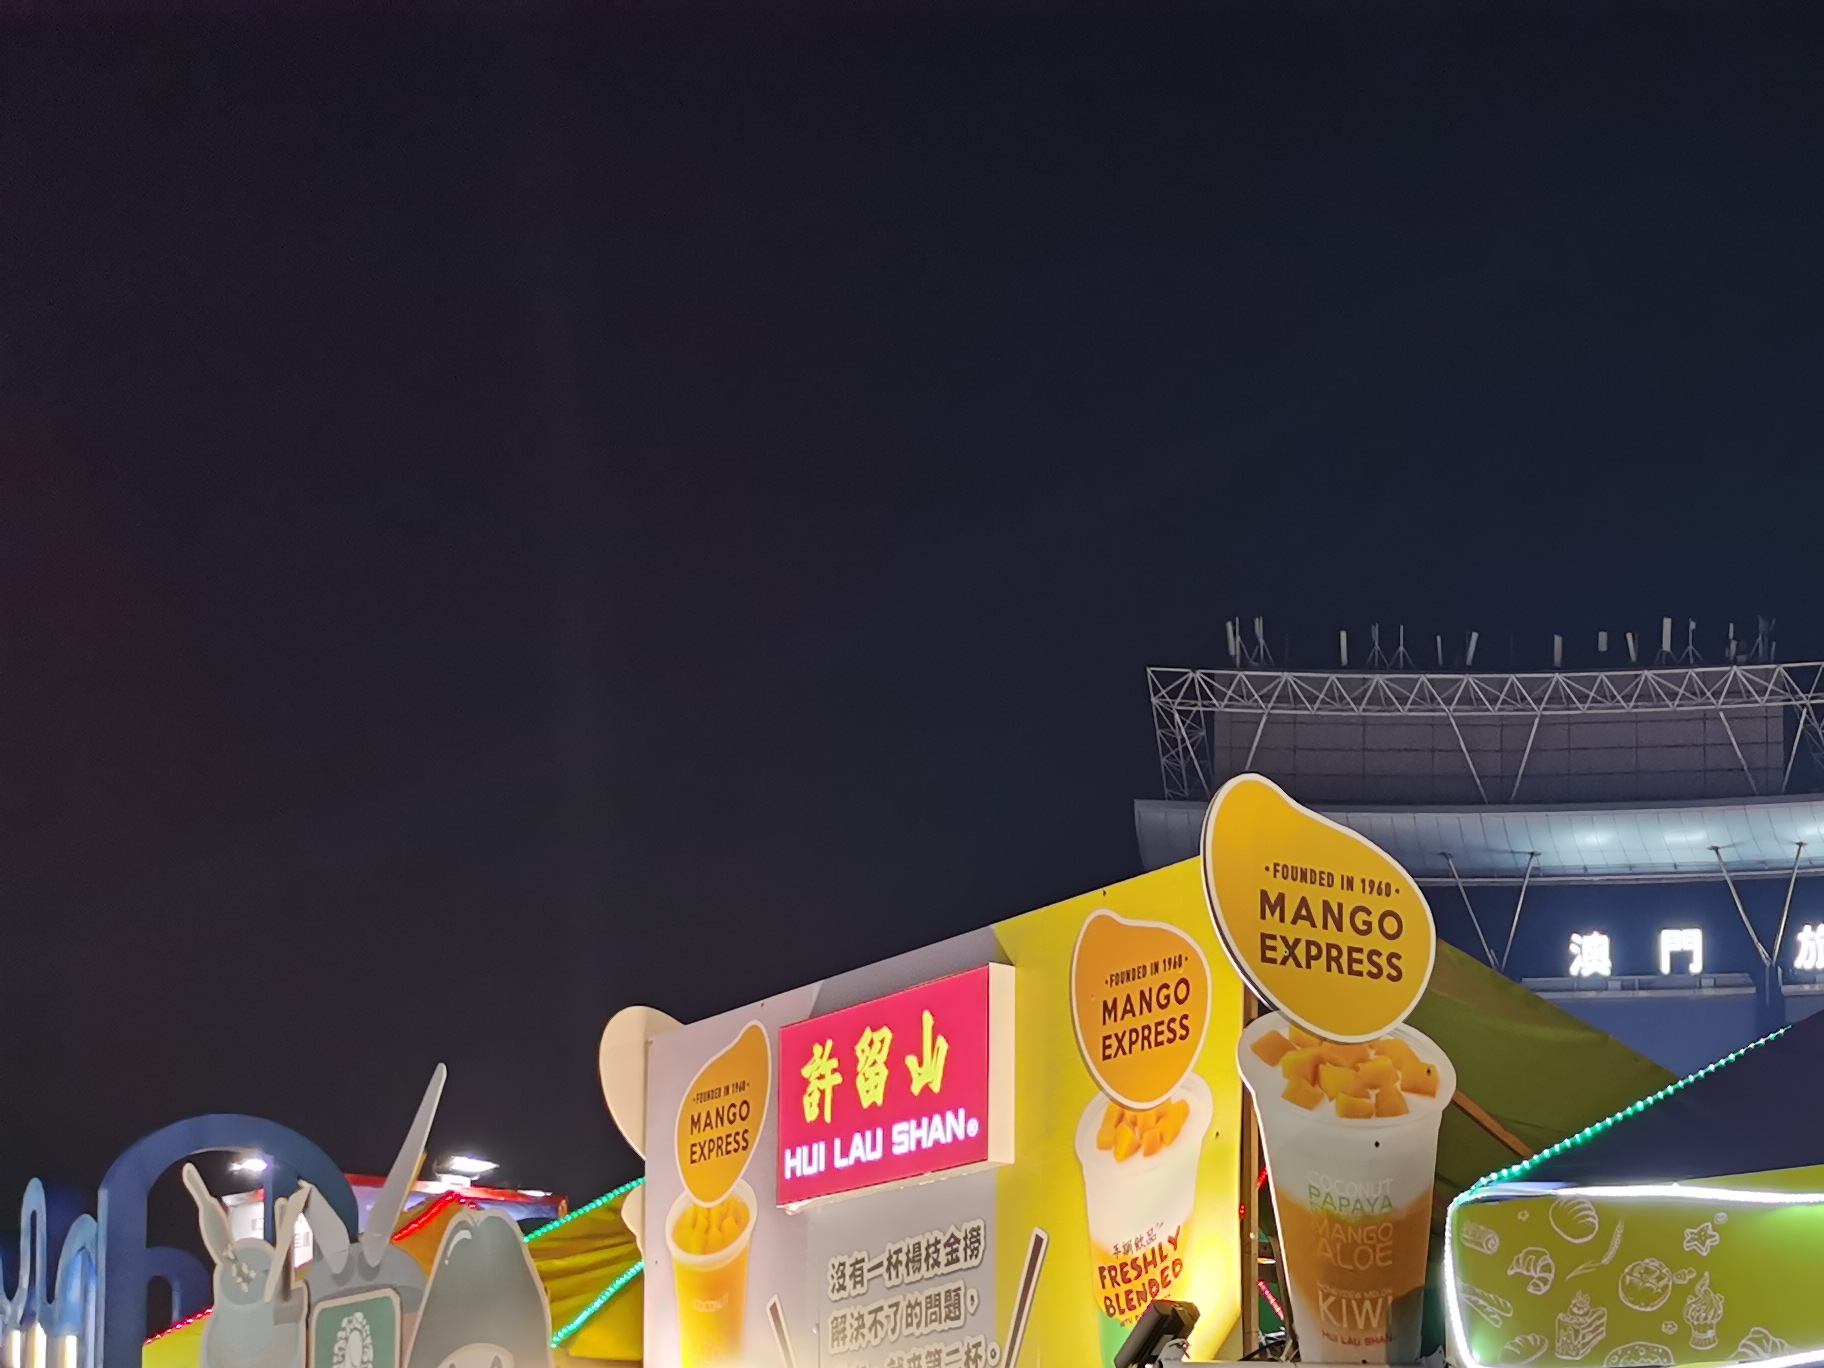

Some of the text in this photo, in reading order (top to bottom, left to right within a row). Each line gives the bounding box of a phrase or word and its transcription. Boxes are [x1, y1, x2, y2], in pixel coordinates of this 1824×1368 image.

[1273, 862, 1392, 898] FOUNDED IN 1960
[1260, 888, 1403, 941] MANGO
[1109, 953, 1183, 988] FOUNDED IN 1960
[1260, 932, 1403, 983] EXPRESS
[1102, 977, 1190, 1026] MANGO
[1102, 1013, 1190, 1061] EXPRESS
[800, 1009, 950, 1125] 許留山
[690, 1099, 750, 1135] MANGO
[689, 1128, 750, 1165] EXPRESS
[784, 1142, 826, 1180] HUI
[833, 1127, 884, 1169] LAU
[1308, 1184, 1394, 1214] PAPAYA
[1314, 1217, 1394, 1245] MANGO
[1097, 1225, 1181, 1289] FRESHLY
[1316, 1238, 1393, 1271] ALOE
[1103, 1257, 1184, 1318] BLENDED
[1318, 1290, 1393, 1330] KIWI
